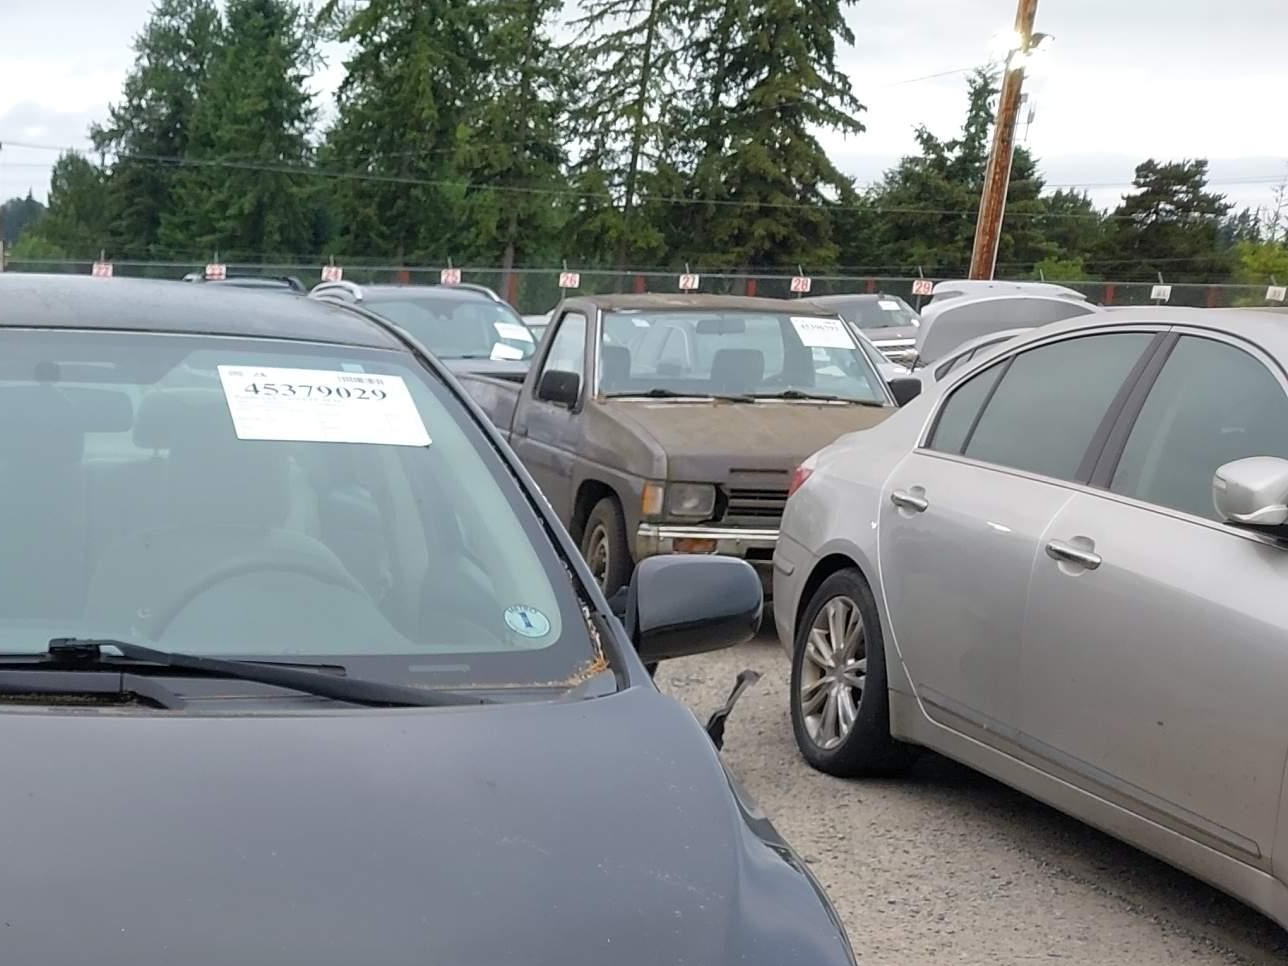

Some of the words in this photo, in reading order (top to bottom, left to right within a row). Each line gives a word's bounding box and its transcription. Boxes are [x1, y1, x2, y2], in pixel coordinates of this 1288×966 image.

[563, 273, 577, 287] 26
[682, 275, 695, 288] 27
[794, 278, 809, 291] 28
[916, 281, 931, 294] 29
[244, 383, 387, 401] 45379029
